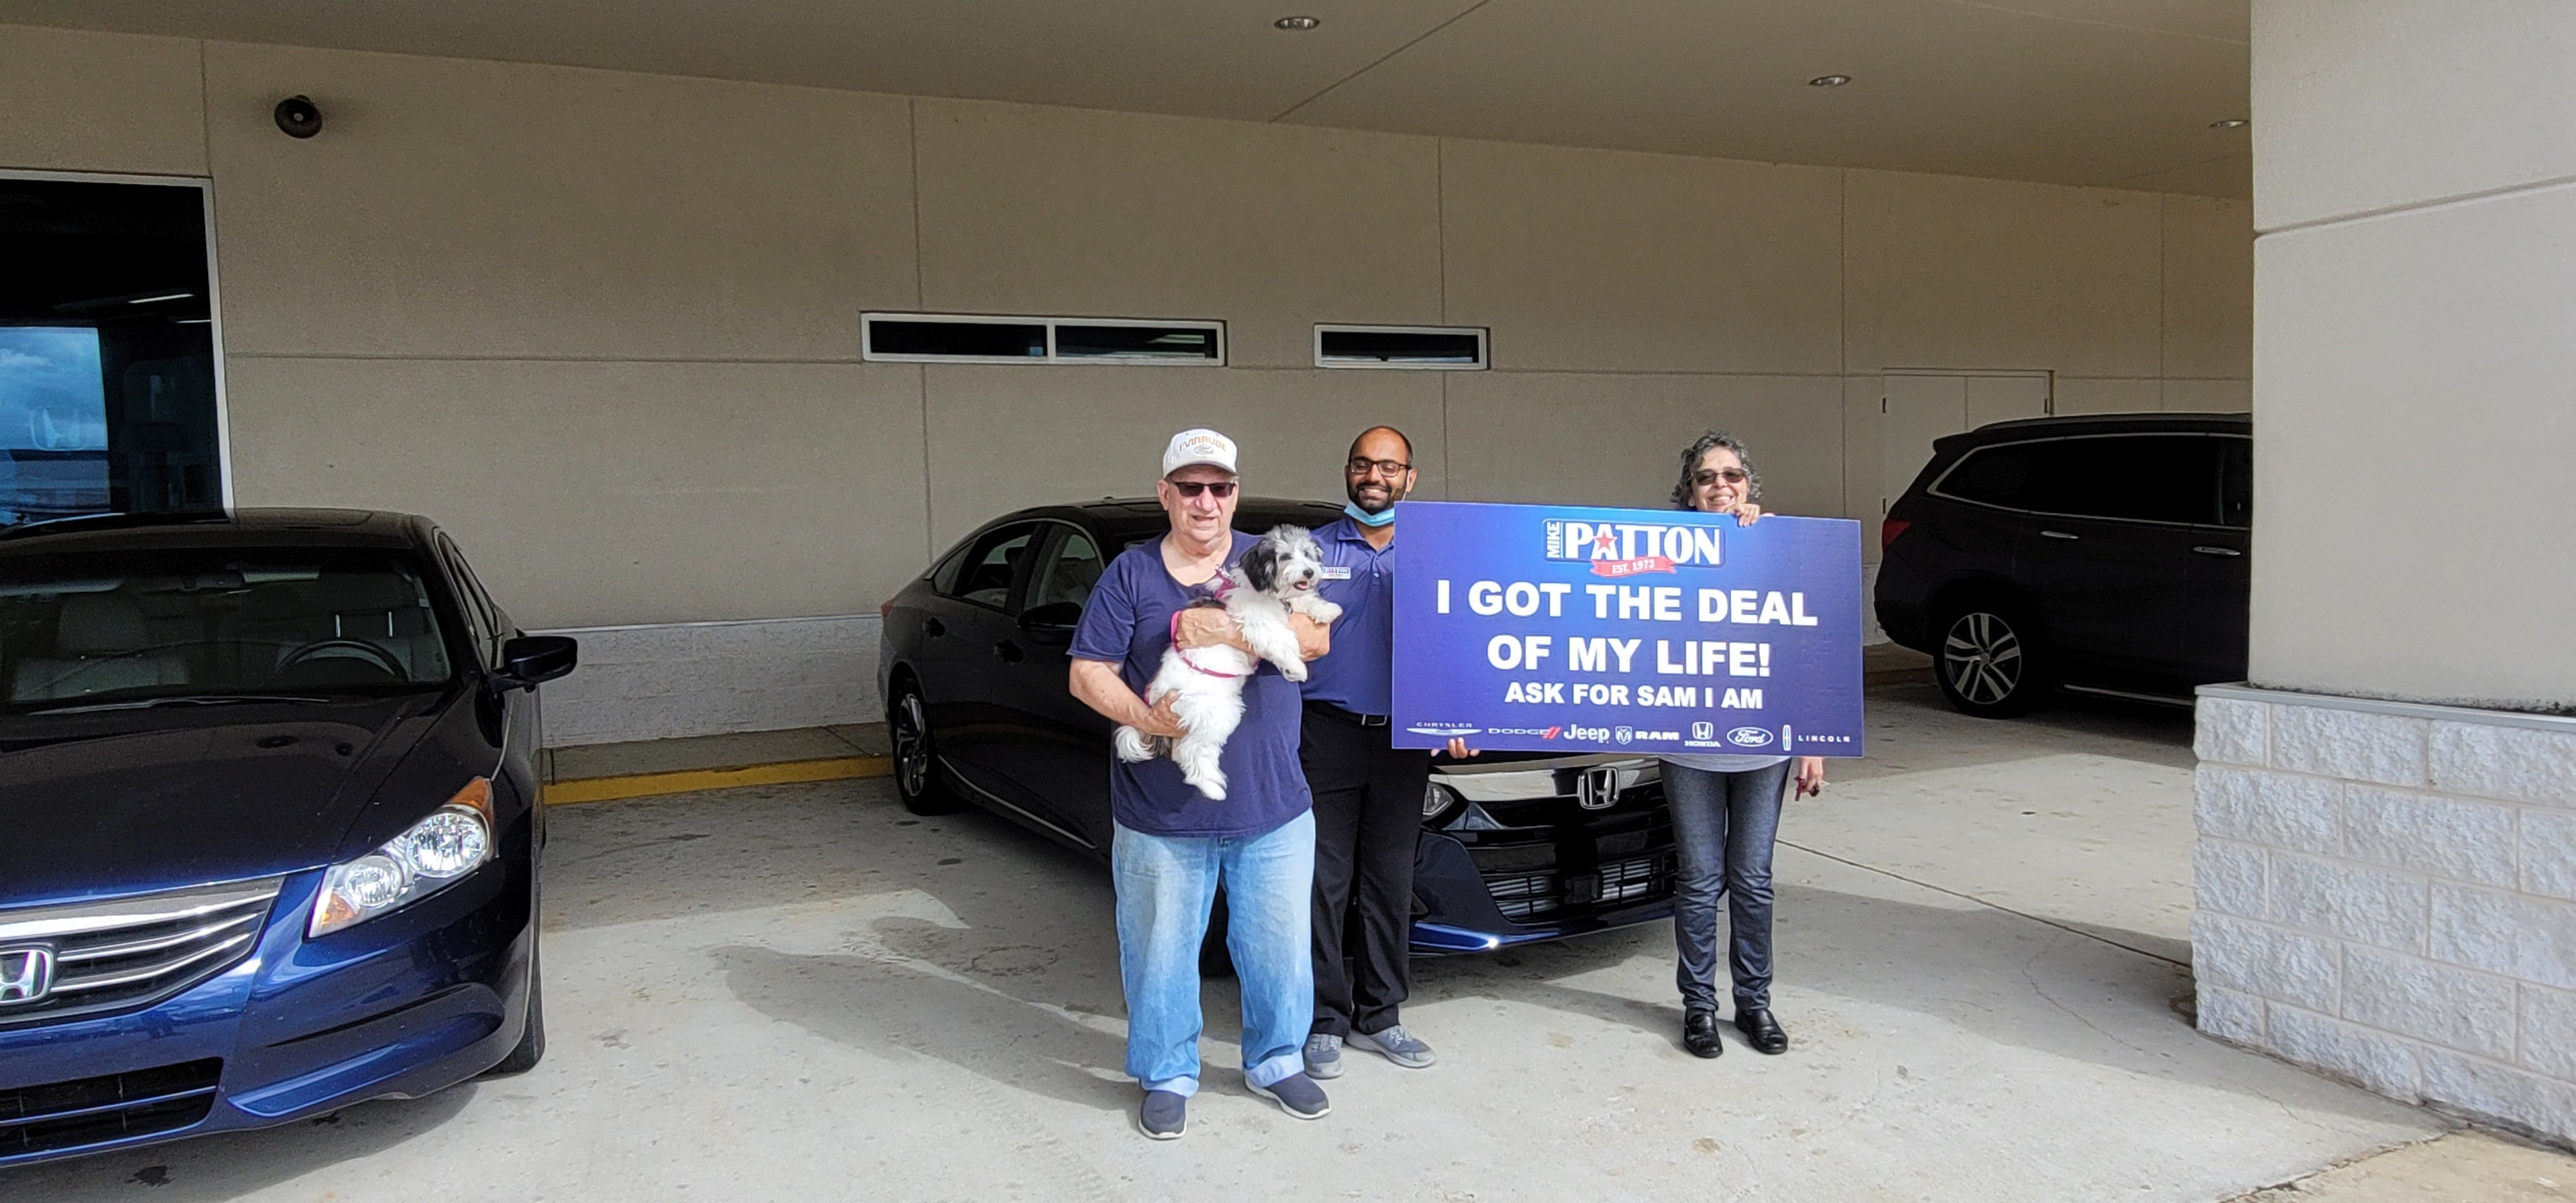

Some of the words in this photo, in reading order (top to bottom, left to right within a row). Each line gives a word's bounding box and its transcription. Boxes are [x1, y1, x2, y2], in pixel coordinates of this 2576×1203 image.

[1546, 522, 1560, 558] MIKE
[1566, 522, 1721, 565] PATTON
[1612, 564, 1630, 574] EST.
[1633, 558, 1655, 572] 1973
[1437, 580, 1450, 614] I
[1468, 581, 1571, 617] GOT
[1586, 585, 1682, 621] THE
[1698, 589, 1818, 626] DEAL
[1487, 634, 1552, 670] OF
[1569, 637, 1642, 673] MY
[1657, 639, 1770, 677] LIFE!
[1504, 682, 1565, 705] ASK
[1573, 683, 1630, 706] FOR
[1636, 685, 1696, 708] SAM
[1705, 687, 1714, 708] I
[1720, 688, 1763, 709] AM
[1488, 727, 1552, 735] DODGE
[1563, 724, 1610, 744] Jeep
[1634, 730, 1680, 741] RAM
[1734, 729, 1766, 744] Ford
[1798, 735, 1851, 743] LINCOLN
